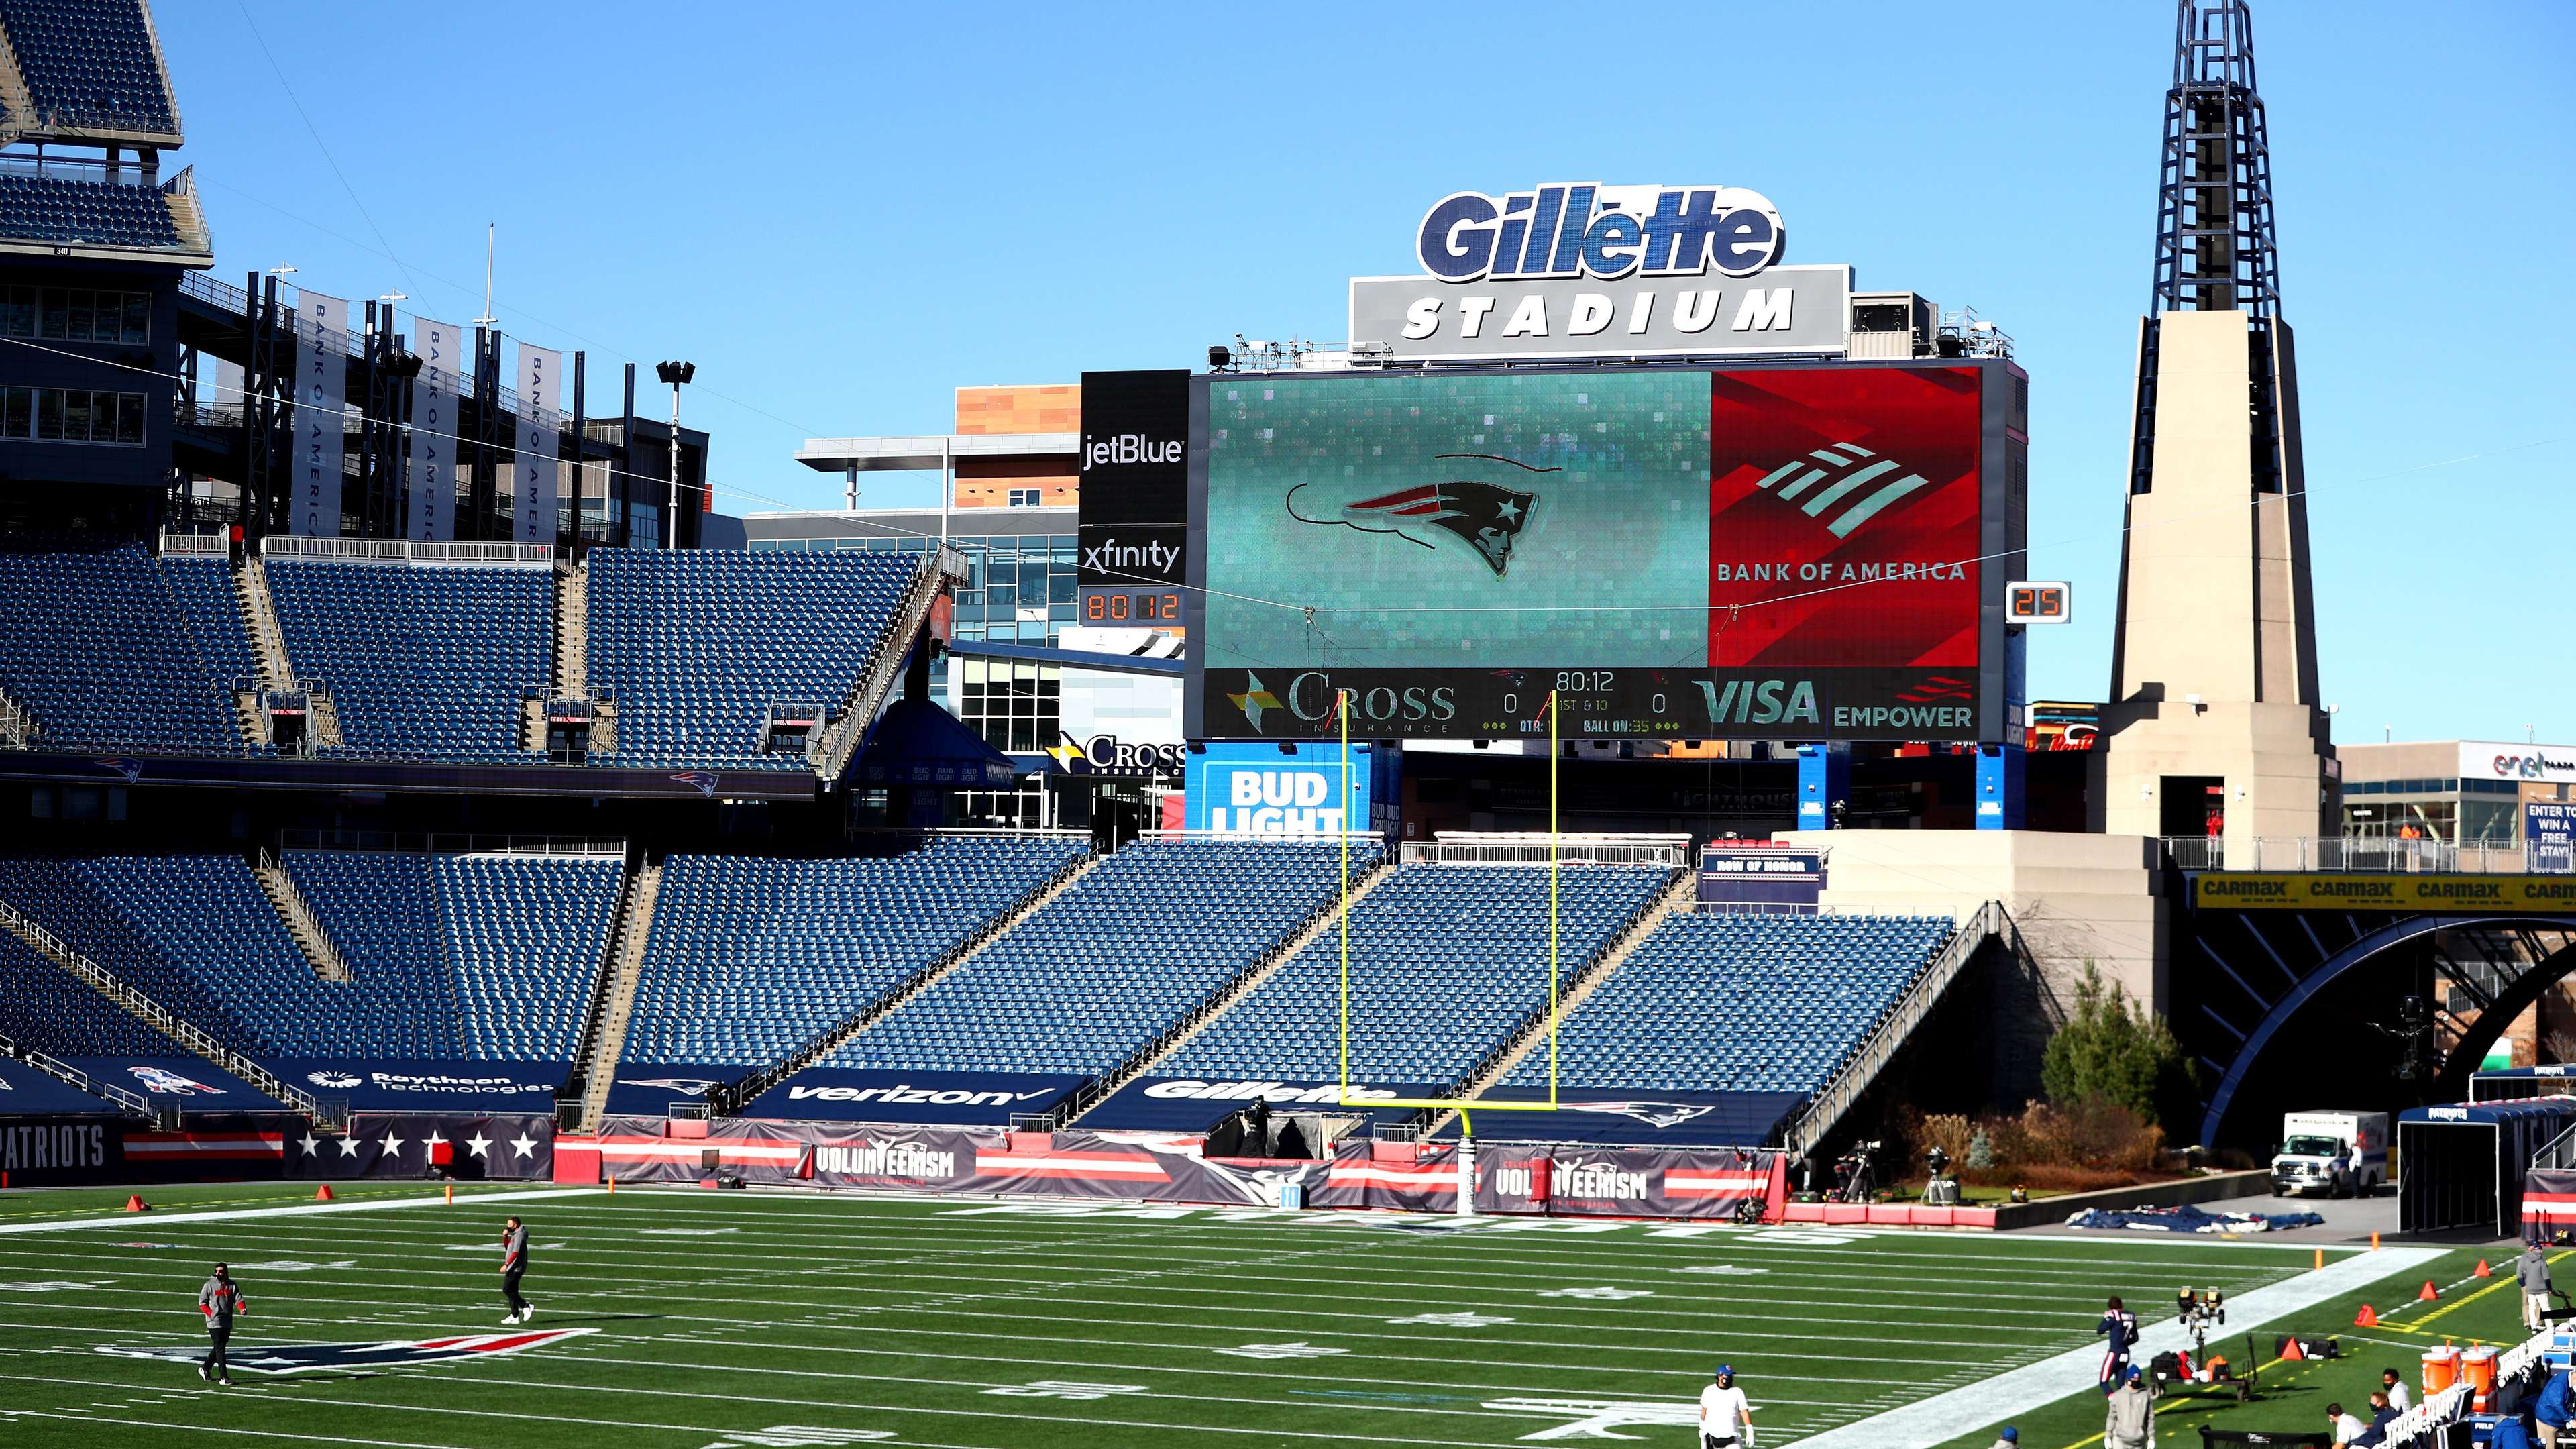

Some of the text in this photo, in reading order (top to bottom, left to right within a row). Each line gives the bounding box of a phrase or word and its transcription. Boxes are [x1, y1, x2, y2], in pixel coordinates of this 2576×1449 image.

[1418, 183, 1779, 279] Gillette
[56, 247, 68, 255] 340
[1401, 288, 1794, 340] STADIUM
[314, 304, 325, 376] BANK
[429, 330, 440, 399] BANK
[531, 356, 542, 424] BANK
[313, 384, 323, 419] OF
[427, 407, 437, 441] OF
[1083, 433, 1183, 471] jetBlue
[1084, 538, 1181, 574] xfinity
[1717, 561, 1966, 582] BANK OF AMERICA
[1087, 594, 1178, 620] 80 12
[2015, 589, 2059, 616] 25
[1556, 671, 1614, 692] 80:12
[1503, 693, 1517, 714] 0
[1559, 700, 1577, 711] 1ST
[1596, 700, 1608, 711] 10
[1652, 693, 1666, 714] 0
[1691, 680, 1819, 724] VISA
[1583, 720, 1609, 733] BALL
[1833, 706, 1972, 727] EMPOWER
[1299, 724, 1448, 733] INSURANCE
[2493, 751, 2544, 778] enel
[1230, 771, 1328, 807] BUD
[1371, 802, 1385, 819] BUD
[1386, 804, 1400, 821] BUD
[2529, 805, 2563, 817] ENTER
[1212, 807, 1344, 841] LIGHT
[2538, 818, 2571, 831] WIN A
[2541, 833, 2568, 843] FREE
[1717, 861, 1806, 872] ROW OF HONOR
[371, 1073, 511, 1085] Raytheon
[2534, 1065, 2565, 1076] PATRIOTS
[374, 1081, 555, 1095] Technologies
[788, 1085, 1016, 1106] verizon
[1144, 1080, 1397, 1104] Gillette
[2428, 1107, 2468, 1120] PATRIOTS
[0, 1124, 103, 1169] ATRIOTS
[1495, 1168, 1647, 1200] VOLNTEERISM
[2123, 1320, 2133, 1340] 7
